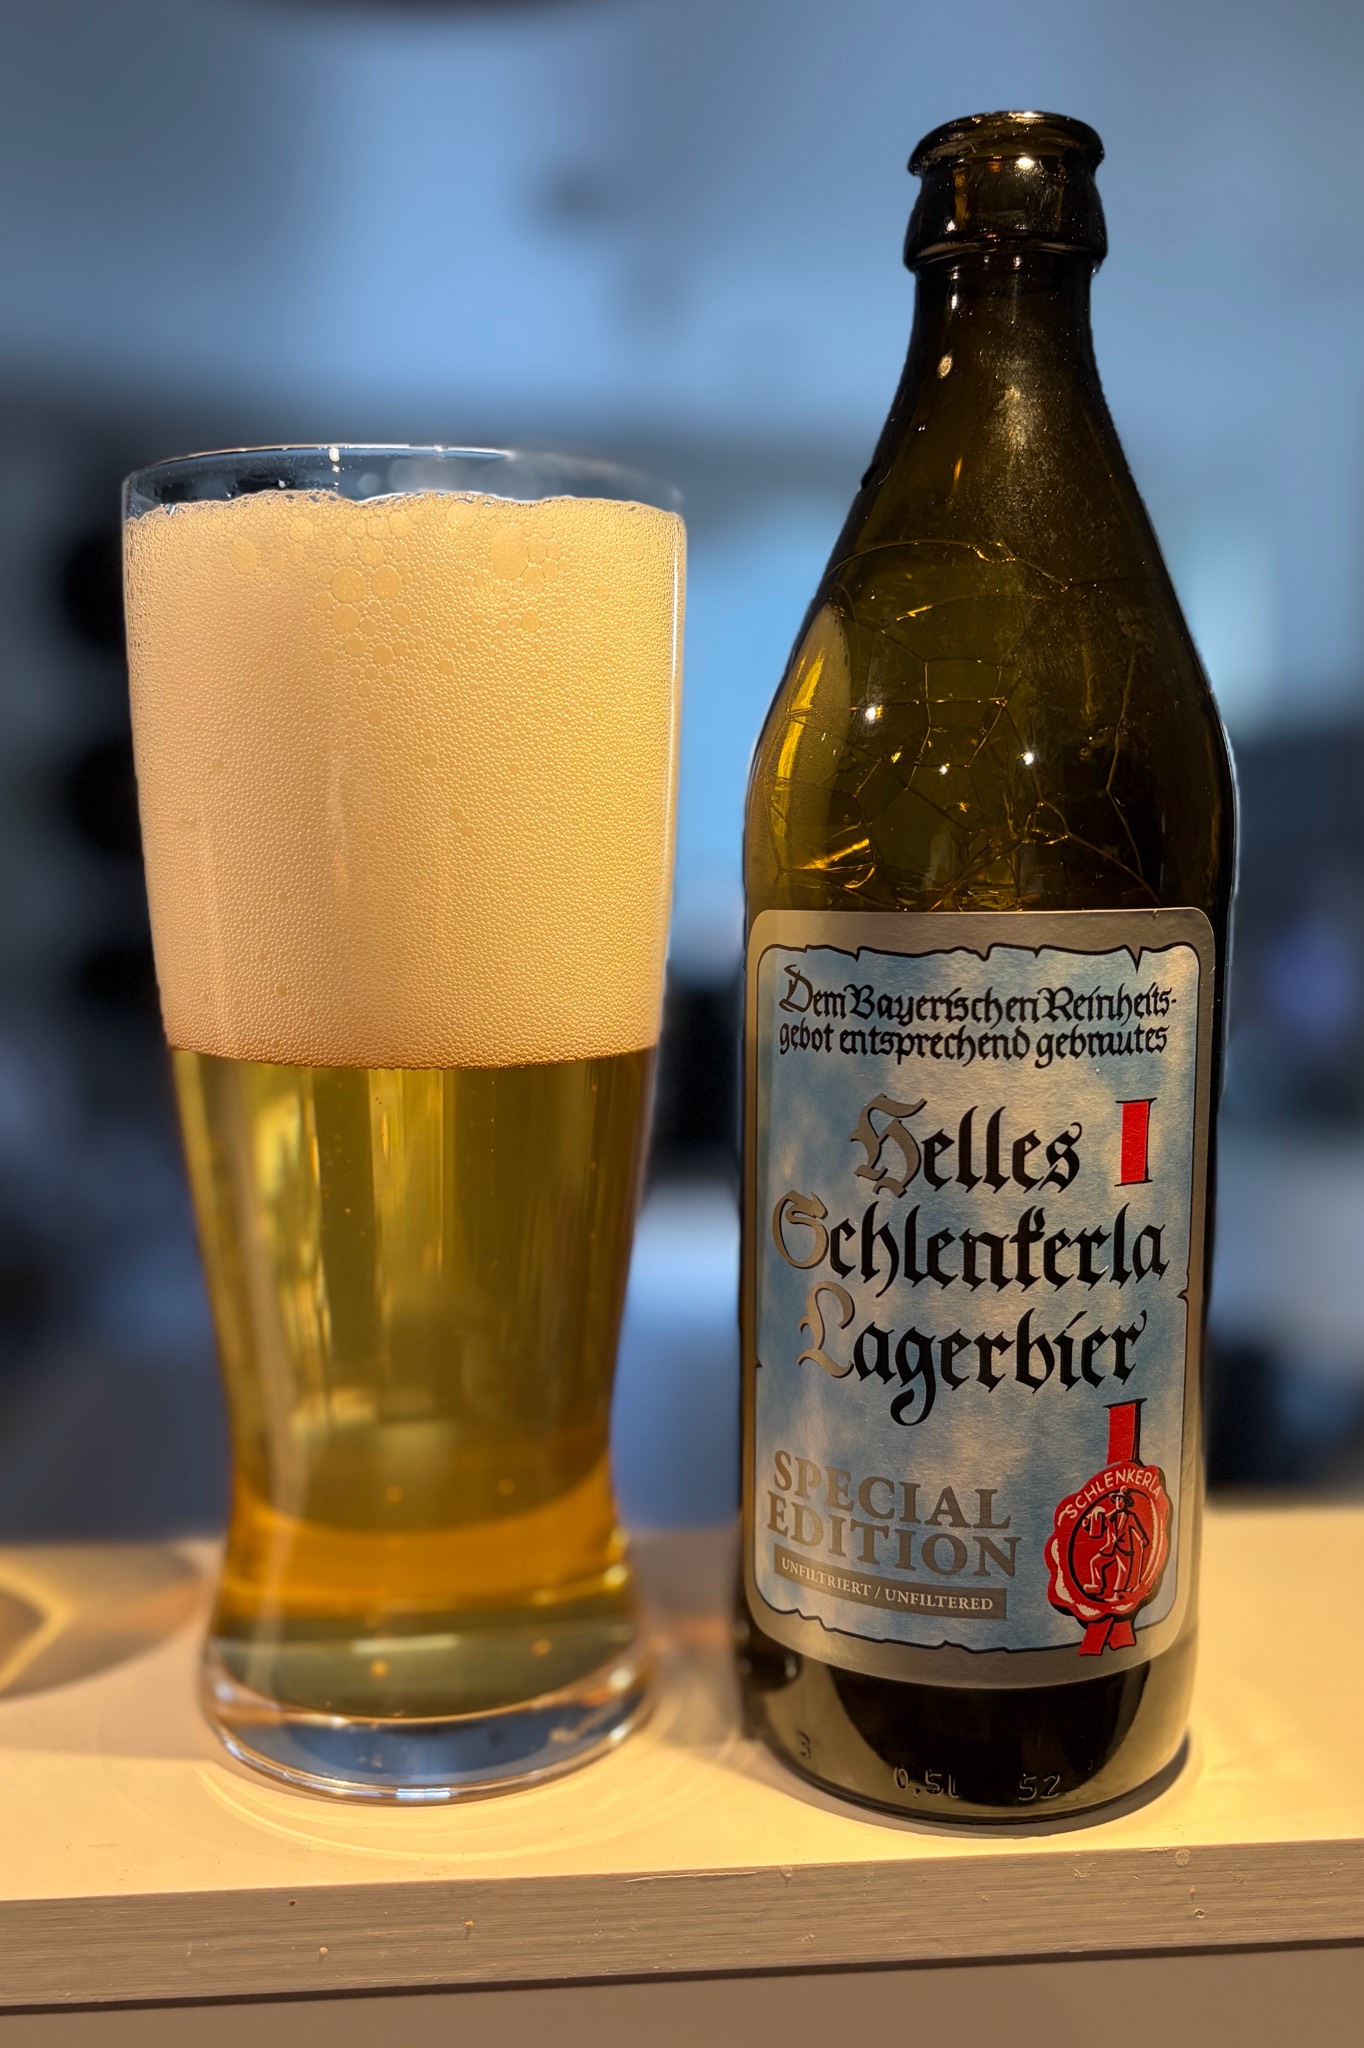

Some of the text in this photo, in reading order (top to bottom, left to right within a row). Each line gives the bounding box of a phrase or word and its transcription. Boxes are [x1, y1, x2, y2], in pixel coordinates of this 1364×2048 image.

[779, 964, 846, 1019] Dem
[843, 983, 1040, 1030] Bayerischen
[779, 1017, 1170, 1069] gebot entsprechend gebrautes
[848, 1093, 1084, 1199] Helles
[772, 1189, 1170, 1298] Schlenkerla
[797, 1280, 1148, 1427] Lagerbier
[773, 1449, 1012, 1530] SPECIAL
[1065, 1467, 1162, 1519] SCHLENKERLA
[767, 1490, 1022, 1578] EDITION
[781, 1556, 994, 1611] UNFILTRIERT / UNFILTERED
[1017, 1773, 1061, 1801] 52
